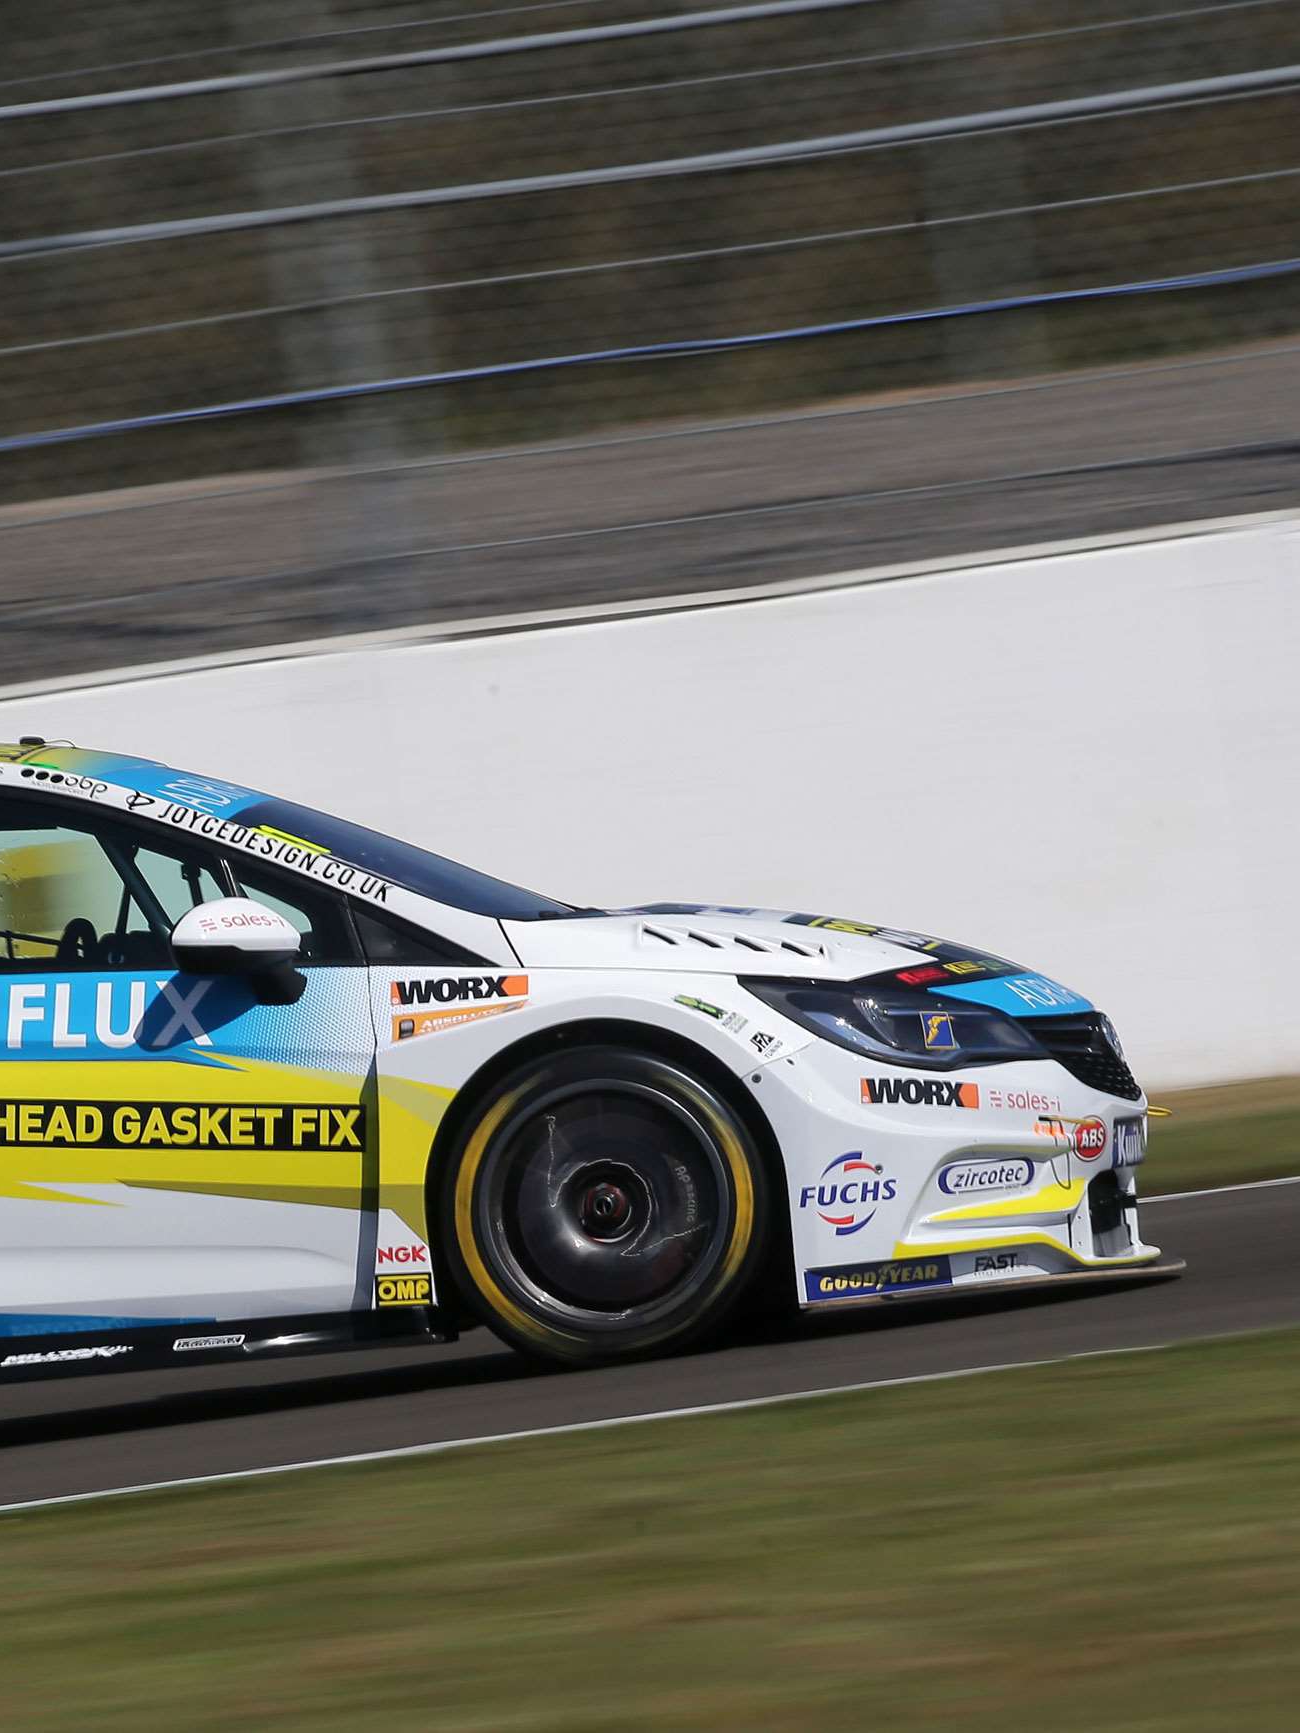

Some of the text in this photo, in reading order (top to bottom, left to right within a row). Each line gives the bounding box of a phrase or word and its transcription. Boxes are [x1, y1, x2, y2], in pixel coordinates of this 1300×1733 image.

[65, 776, 108, 799] obp
[158, 802, 394, 902] JOYCEDESIGN.CO.UK
[221, 913, 286, 928] sales-i
[396, 976, 509, 1005] WORX
[868, 1078, 964, 1107] WORX
[1006, 1089, 1061, 1112] sales-i
[112, 1106, 283, 1146] GASKET
[292, 1108, 361, 1147] FIX
[1080, 1126, 1105, 1148] ABS
[953, 1163, 1024, 1188] zircotec
[799, 1178, 897, 1208] FUCHS
[377, 1246, 427, 1264] NGK
[378, 1279, 430, 1300] OMP
[818, 1263, 940, 1293] GOODYEAR
